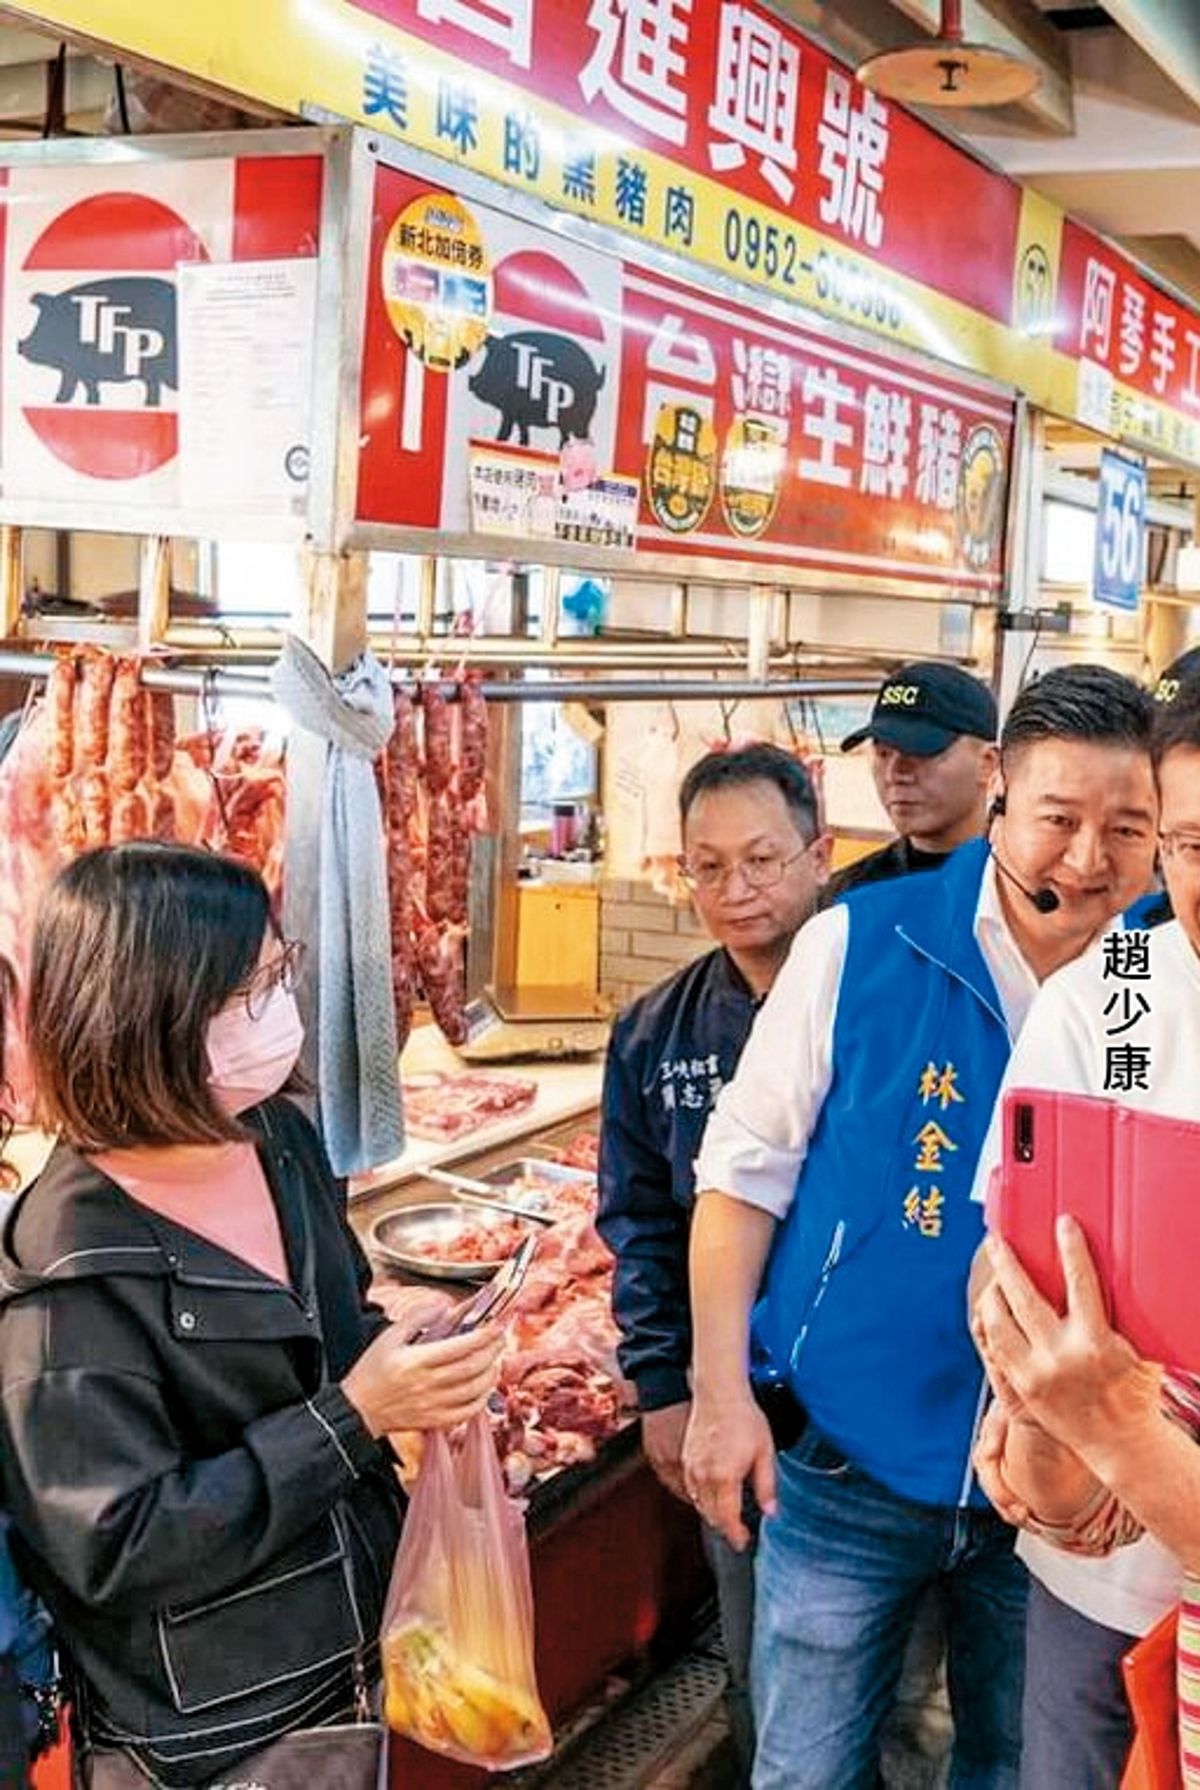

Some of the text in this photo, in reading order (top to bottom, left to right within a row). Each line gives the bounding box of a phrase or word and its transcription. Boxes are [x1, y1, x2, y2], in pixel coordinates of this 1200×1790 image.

[363, 44, 693, 248] 美味的黑豬肉
[73, 296, 165, 362] TFP
[509, 341, 575, 424] TFP
[1101, 474, 1141, 585] 56
[902, 1060, 966, 1238] 林金結
